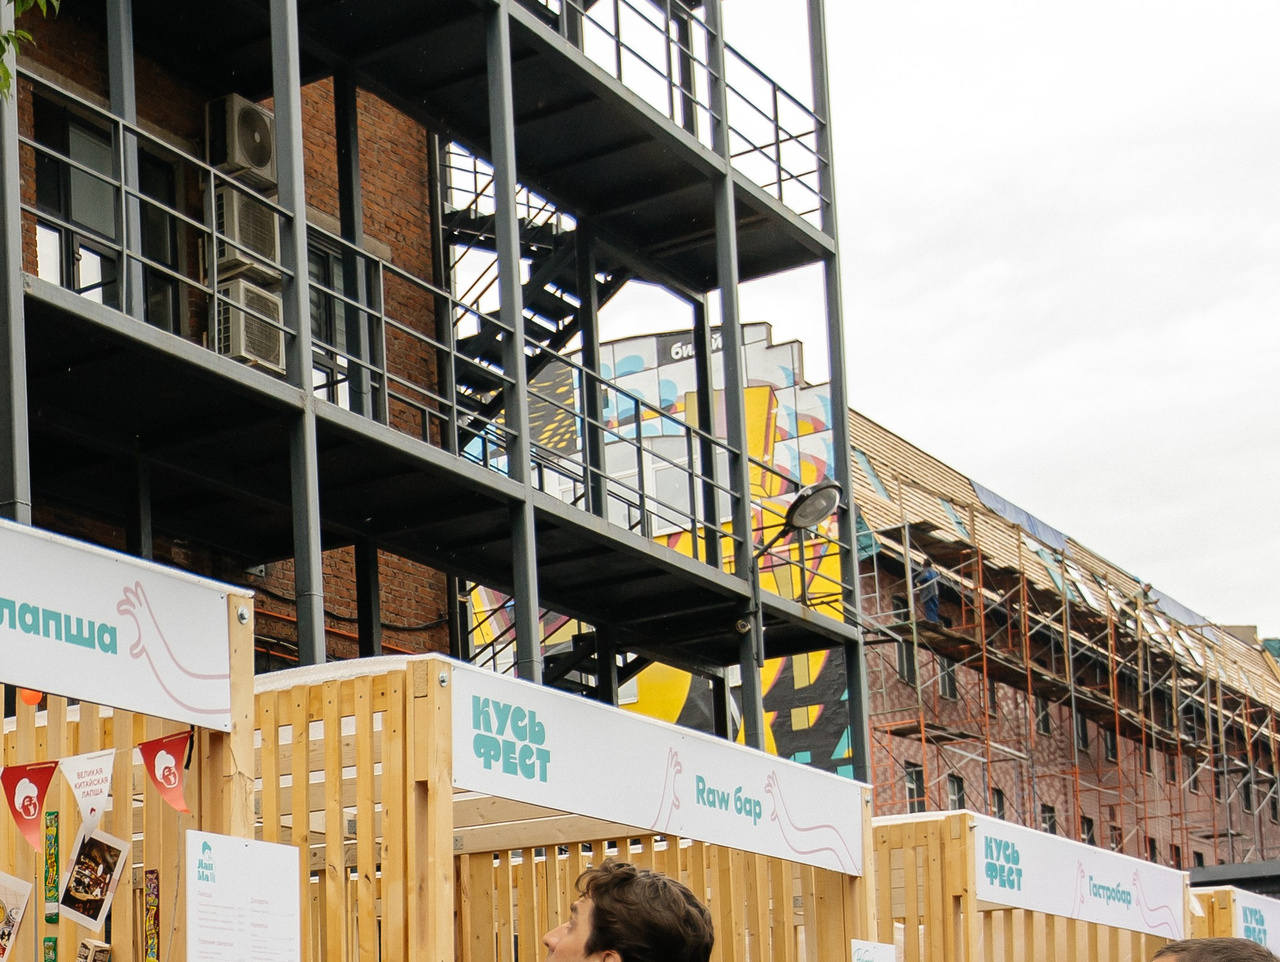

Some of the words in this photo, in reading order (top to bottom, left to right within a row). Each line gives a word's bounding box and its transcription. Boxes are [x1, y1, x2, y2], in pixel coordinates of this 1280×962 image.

[472, 695, 546, 746] КУСЬ
[473, 733, 550, 783] ФЕСТ
[74, 777, 109, 790] КИТАЙСКАЯ
[76, 767, 103, 780] ВЕЛИКАЯ
[81, 787, 104, 798] ЛАПША
[695, 774, 730, 811] Raw
[734, 786, 762, 826] бар
[984, 835, 1019, 866] КУСЬ
[985, 861, 1022, 891] ФЕСТ
[1089, 875, 1131, 910] Гастробар
[1242, 906, 1265, 927] КУСЬ
